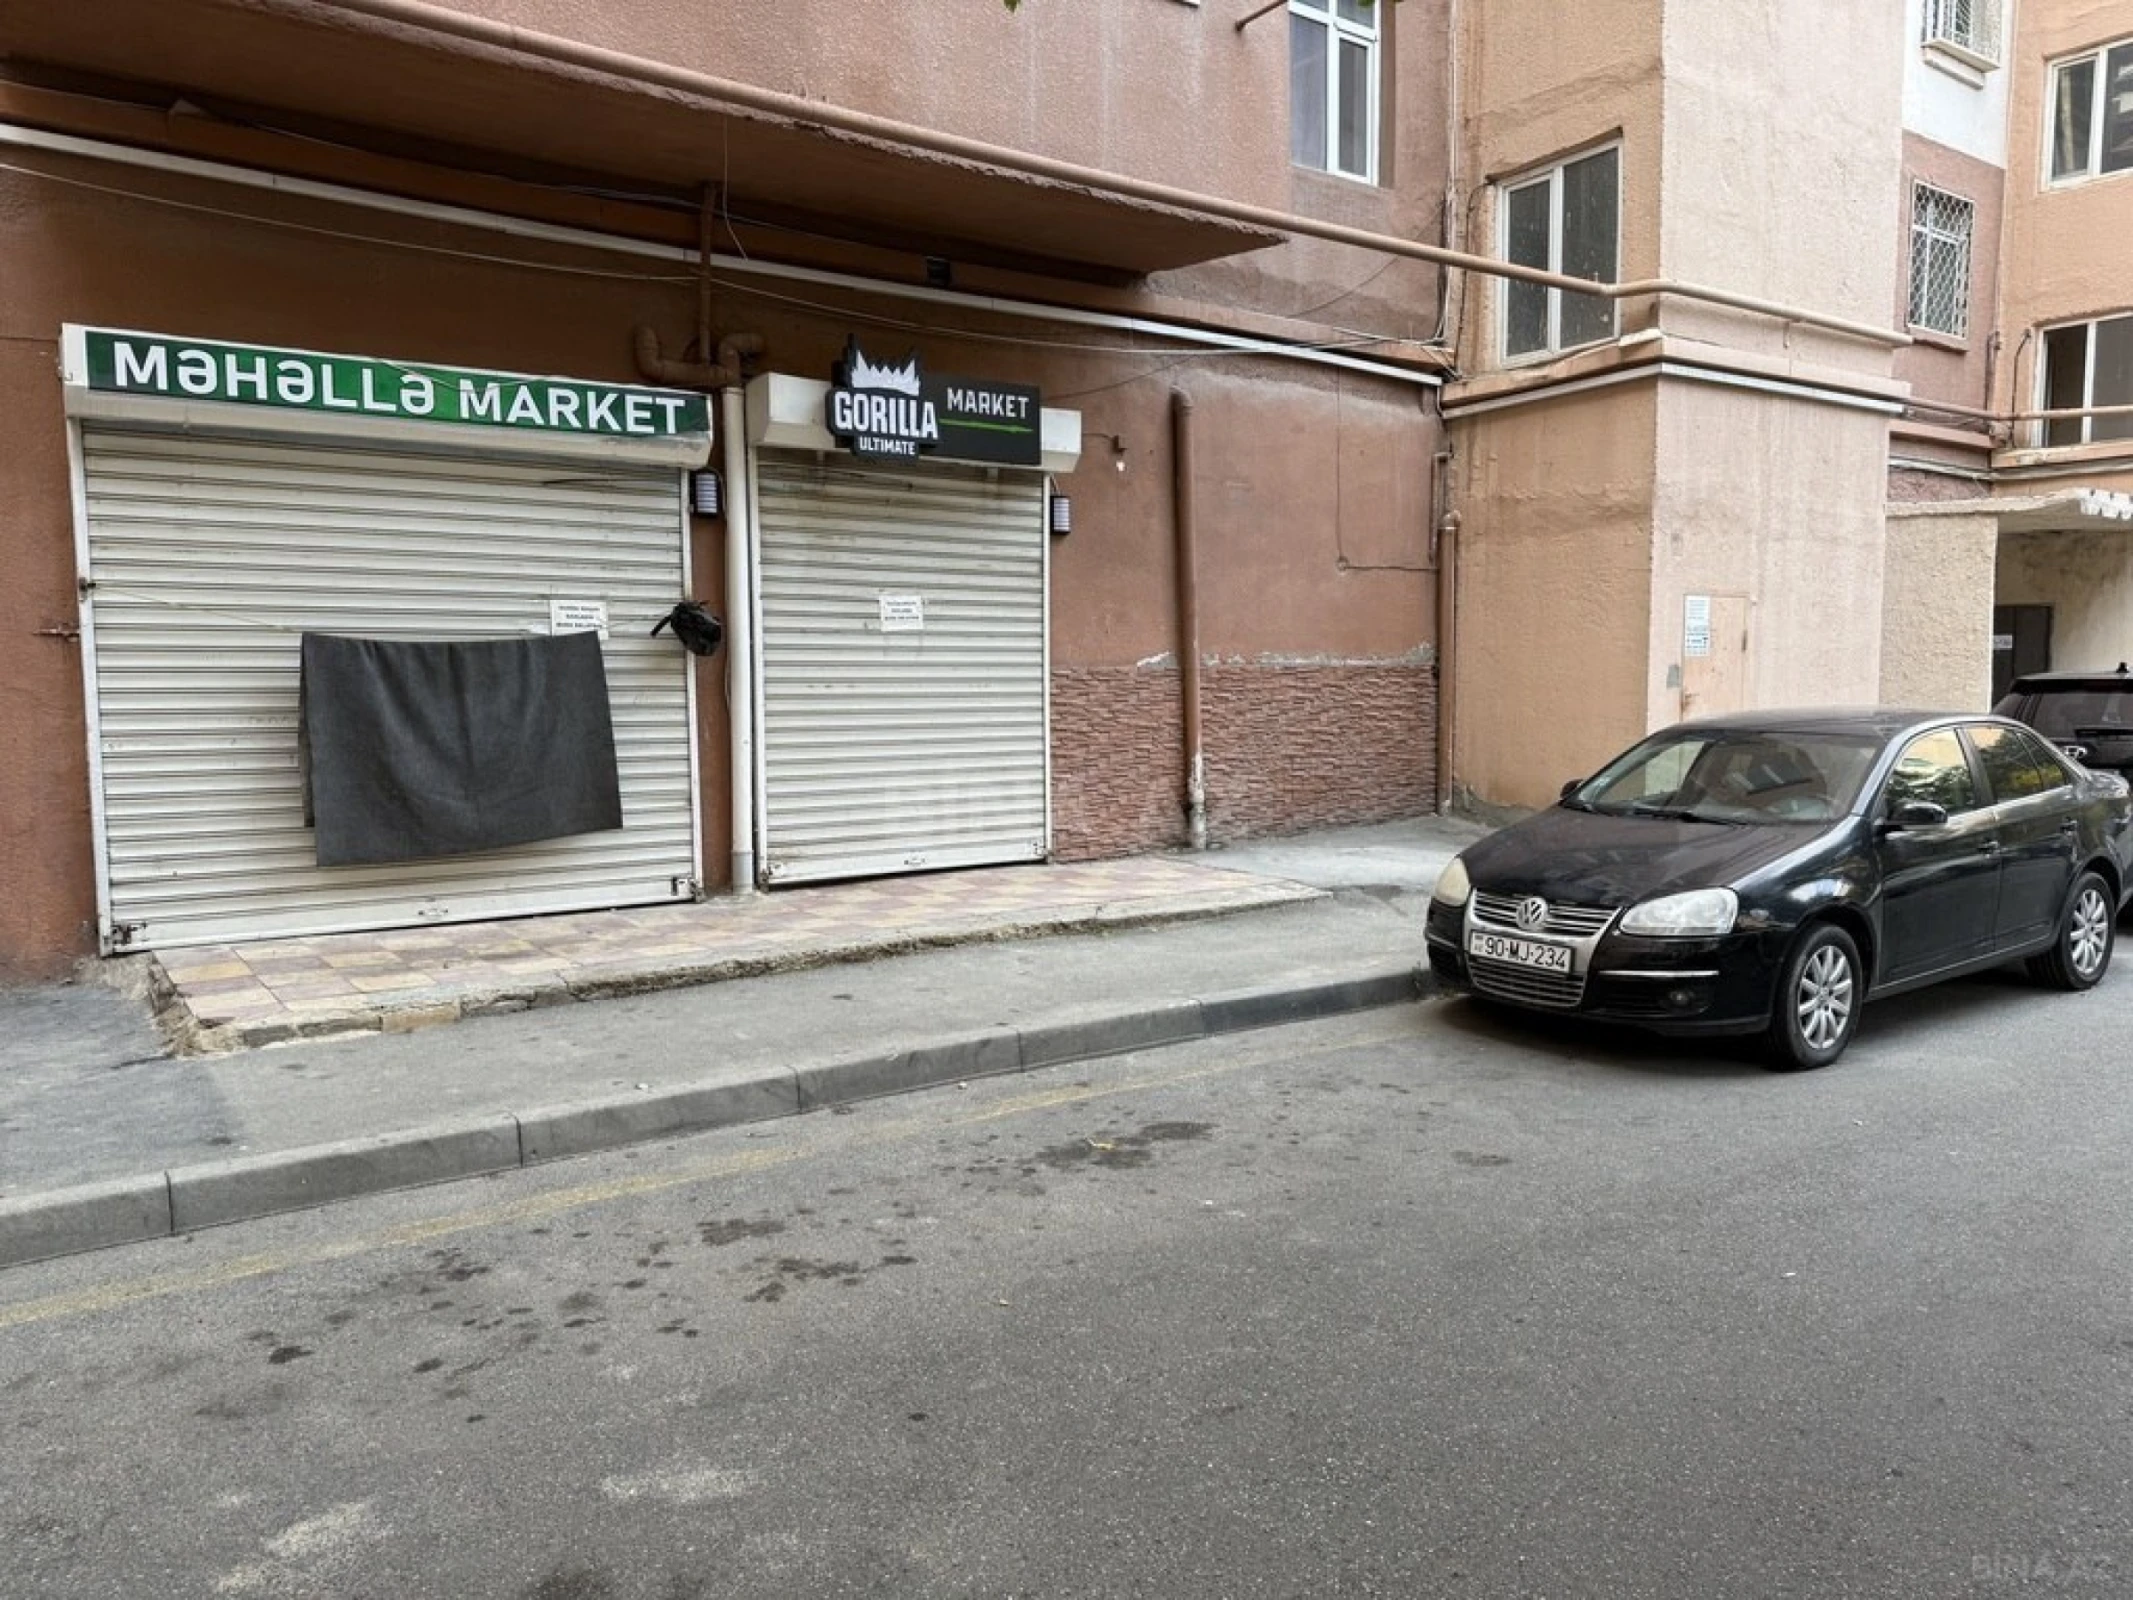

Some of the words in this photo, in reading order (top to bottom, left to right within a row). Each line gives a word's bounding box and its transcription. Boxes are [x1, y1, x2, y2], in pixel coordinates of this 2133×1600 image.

[112, 341, 435, 415] MƏHƏLLƏ
[459, 383, 686, 435] MARKET
[946, 387, 1029, 419] MARKET
[834, 391, 938, 438] GORILLA
[859, 436, 915, 455] ULTIMATE
